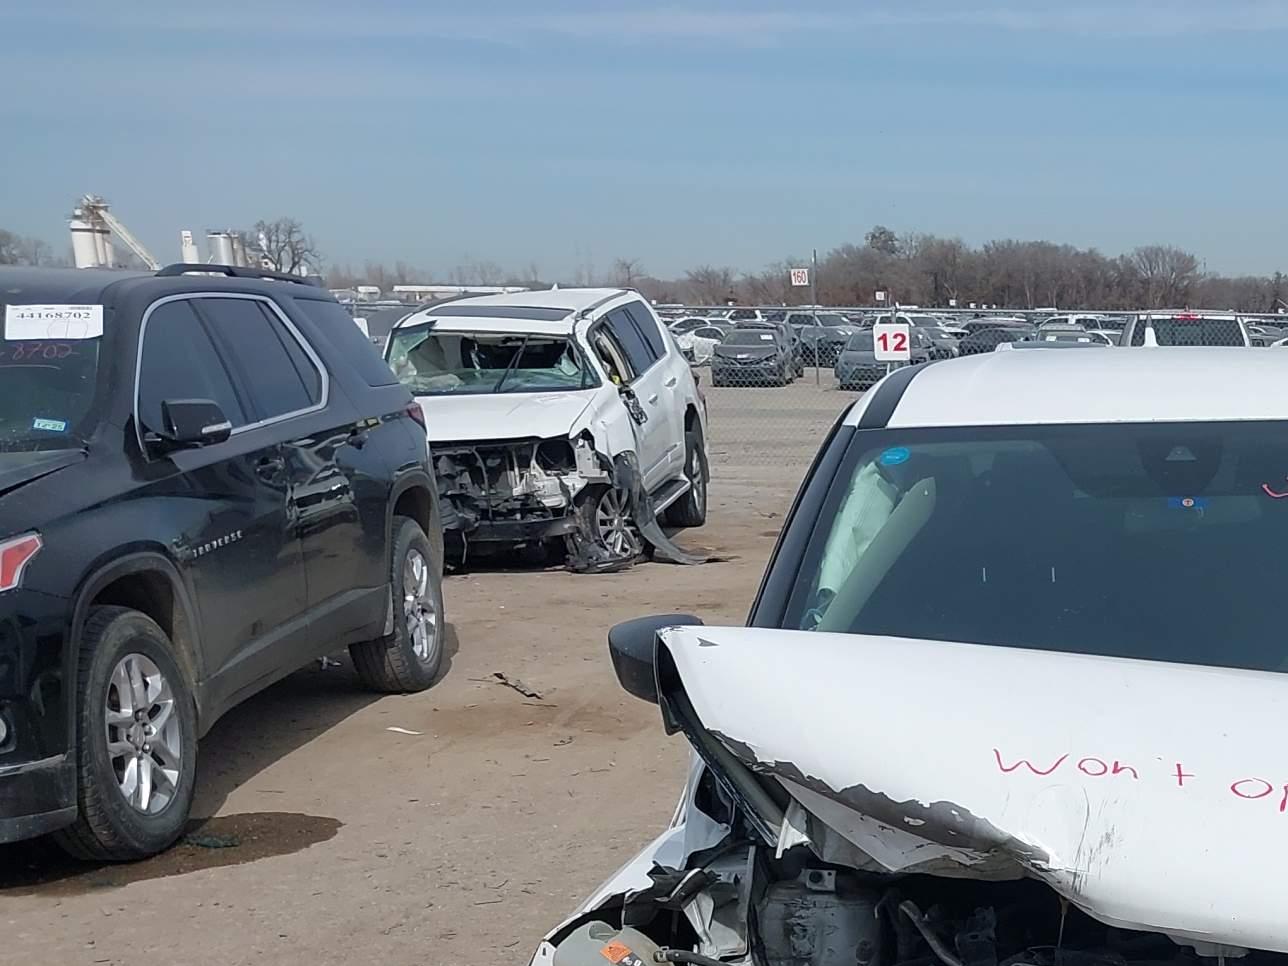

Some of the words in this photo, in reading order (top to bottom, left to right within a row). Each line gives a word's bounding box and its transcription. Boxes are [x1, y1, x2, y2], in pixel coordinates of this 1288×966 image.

[792, 270, 806, 284] 160
[15, 311, 91, 320] 44168702
[877, 332, 908, 352] 12
